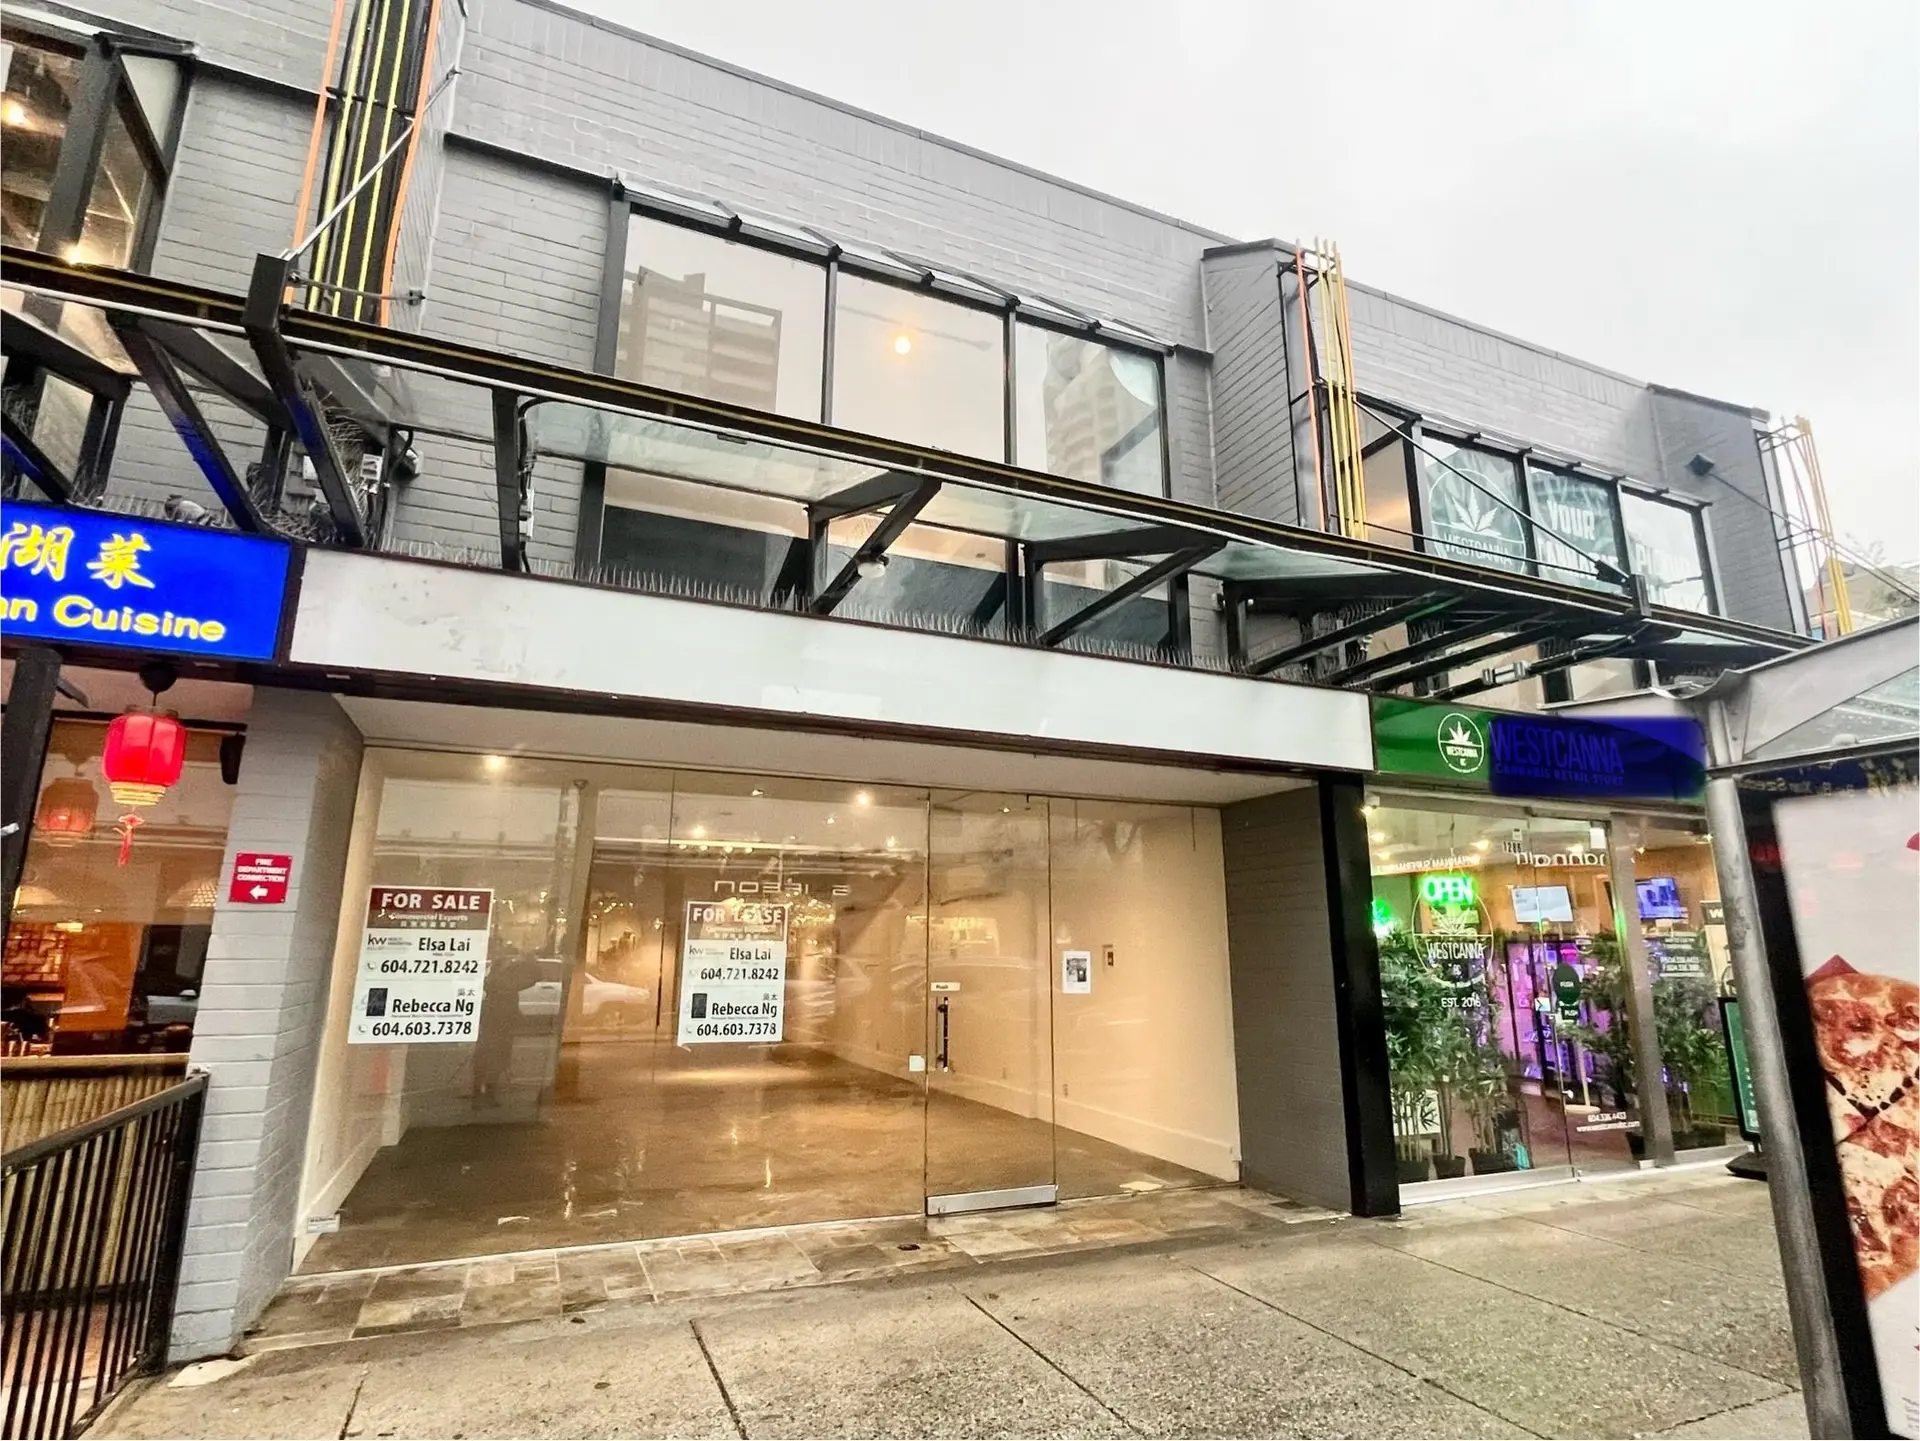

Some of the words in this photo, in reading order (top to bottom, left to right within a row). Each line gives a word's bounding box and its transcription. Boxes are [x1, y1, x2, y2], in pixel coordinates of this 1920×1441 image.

[1547, 500, 1595, 540] YOUR
[53, 595, 226, 642] Cuisine
[1487, 720, 1625, 774] WESTCANNA
[1423, 876, 1474, 904] OPEN
[381, 892, 422, 909] FOR
[431, 894, 481, 910] SALE
[693, 907, 725, 923] FOR
[732, 907, 782, 924] LEASE
[367, 933, 387, 946] kw
[419, 937, 446, 952] Elsa
[449, 937, 471, 952] Lai
[1426, 941, 1485, 960] WESTCANNA
[729, 947, 752, 961] Elsa
[755, 947, 772, 961] Lai
[380, 959, 479, 974] 604.721.8242
[700, 967, 779, 981] 604.721.8242
[392, 998, 452, 1014] Rebecca
[454, 998, 475, 1016] Ng
[711, 1002, 759, 1016] Rebecca
[761, 1002, 778, 1018] Ng
[372, 1021, 473, 1037] 604.603.7378
[696, 1022, 777, 1037] 604.603.7378
